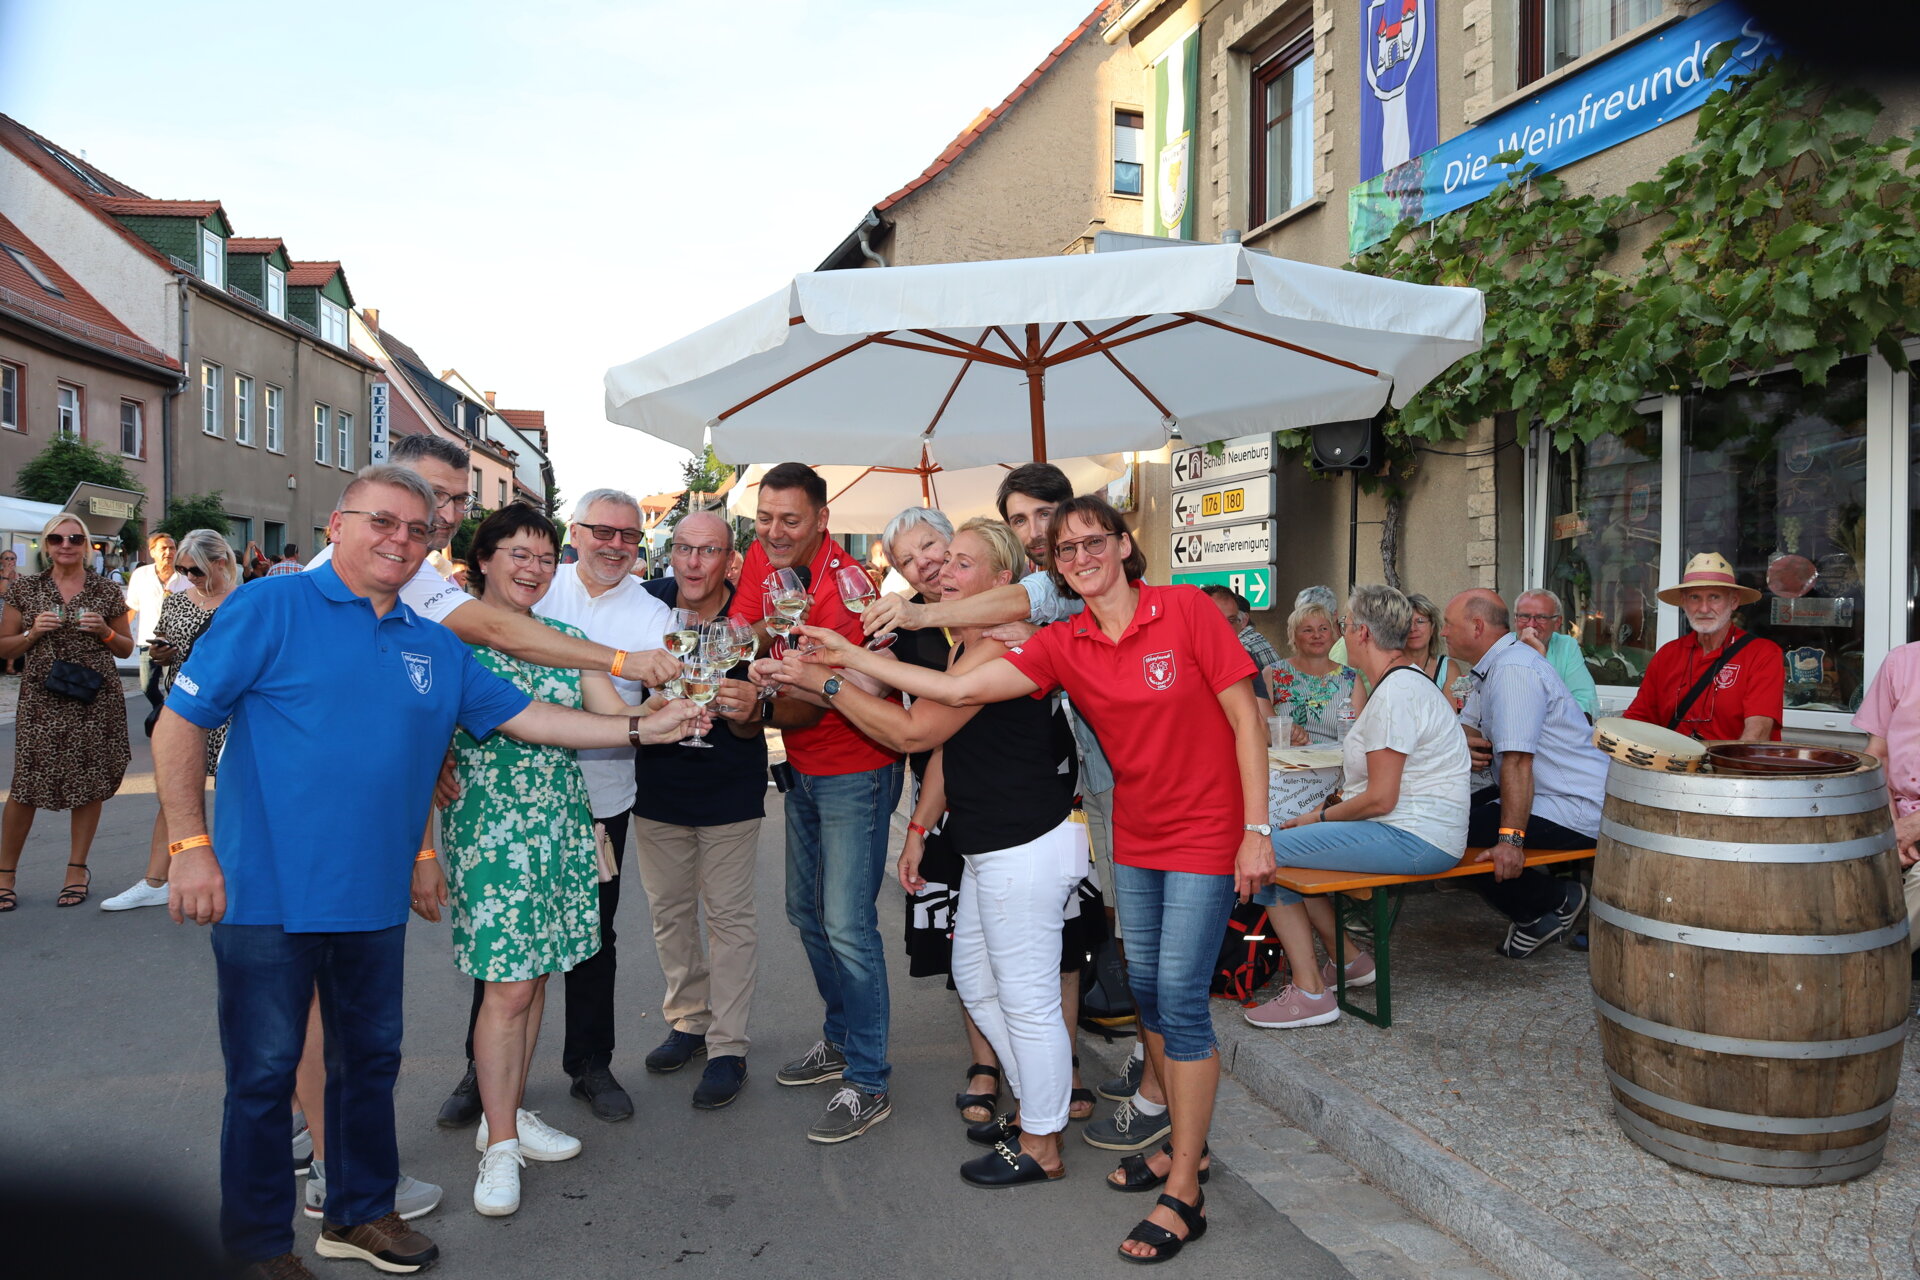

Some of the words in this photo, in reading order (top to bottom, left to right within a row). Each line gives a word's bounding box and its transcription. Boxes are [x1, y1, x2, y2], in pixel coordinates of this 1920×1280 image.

[1443, 153, 1488, 194] Die
[372, 386, 386, 443] TEXTIL
[374, 449, 384, 459] &
[1228, 446, 1269, 464] Neuenburg
[1188, 503, 1200, 514] zur
[1205, 496, 1218, 512] 176
[1226, 493, 1241, 509] 180
[1204, 537, 1269, 554] Winzervereinigung
[1297, 789, 1325, 809] Riesling
